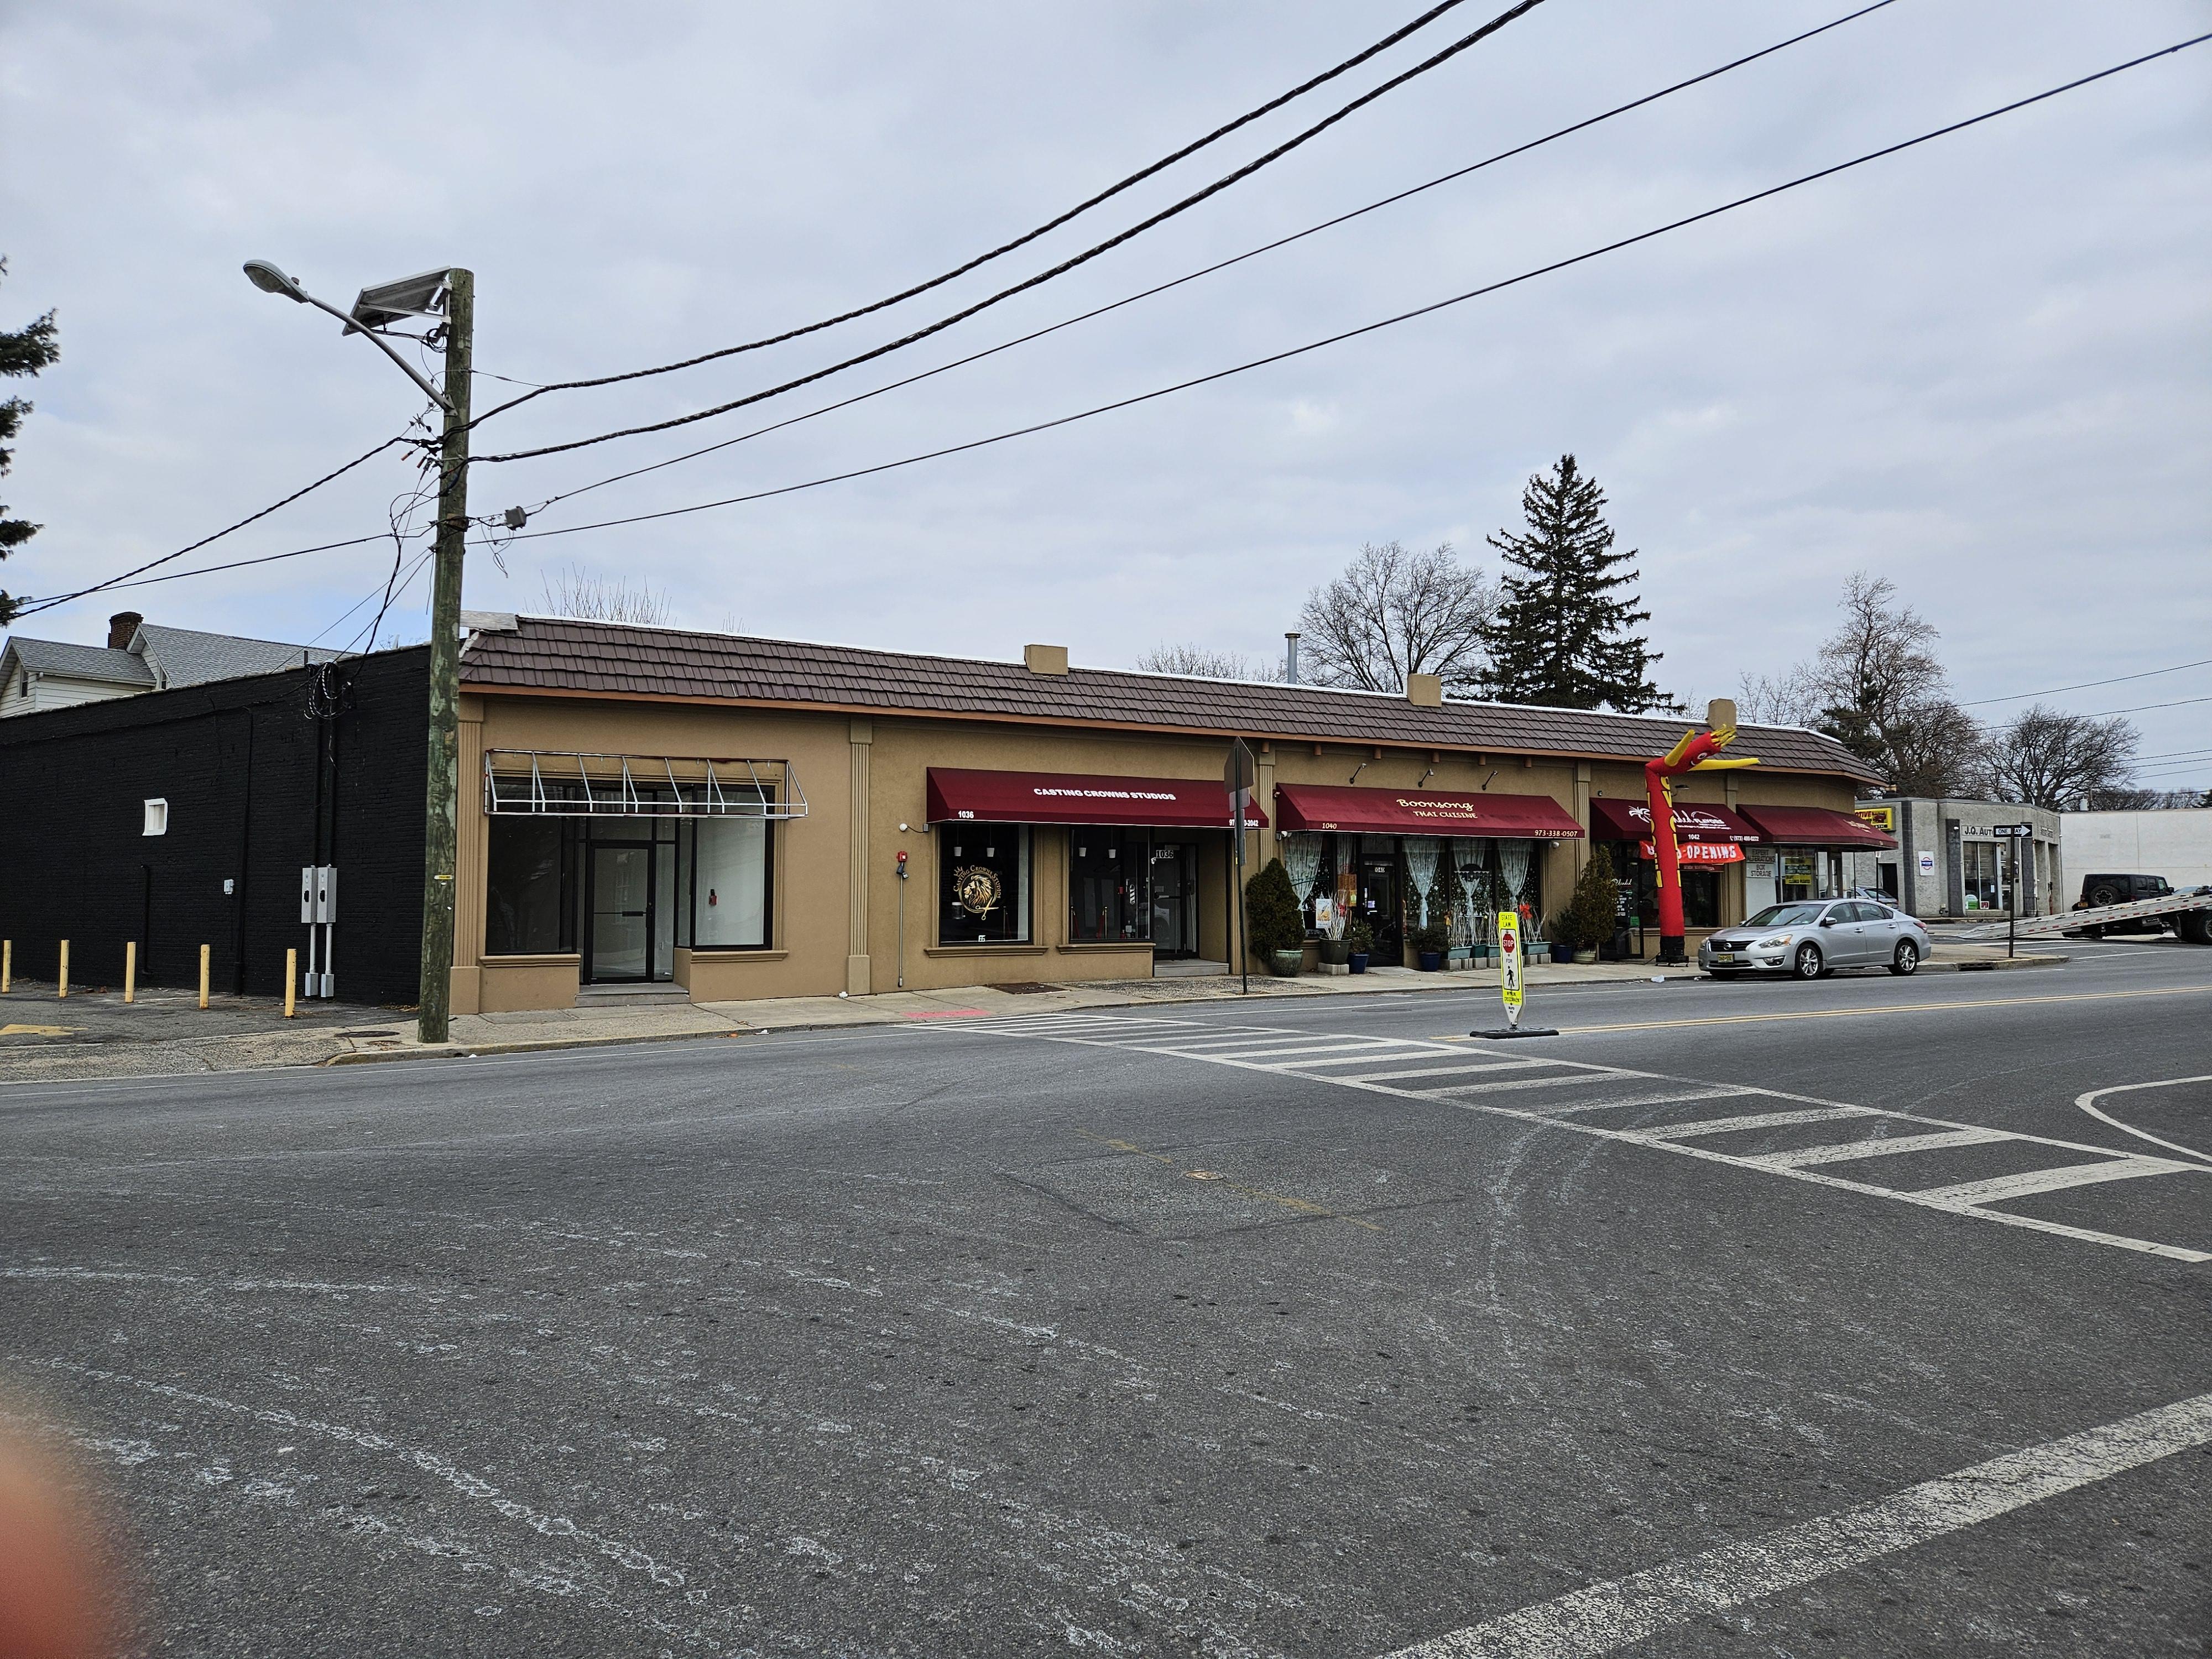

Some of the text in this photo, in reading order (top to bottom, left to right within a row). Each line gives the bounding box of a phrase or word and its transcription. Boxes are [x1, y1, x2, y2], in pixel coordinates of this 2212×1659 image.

[1034, 788, 1176, 800] CASTING CROWNS STUDIOS
[1396, 799, 1474, 812] Boonsong
[1965, 826, 1993, 836] J.Q. AUT
[1156, 850, 1173, 858] 1036
[1687, 845, 1736, 859] OPENING
